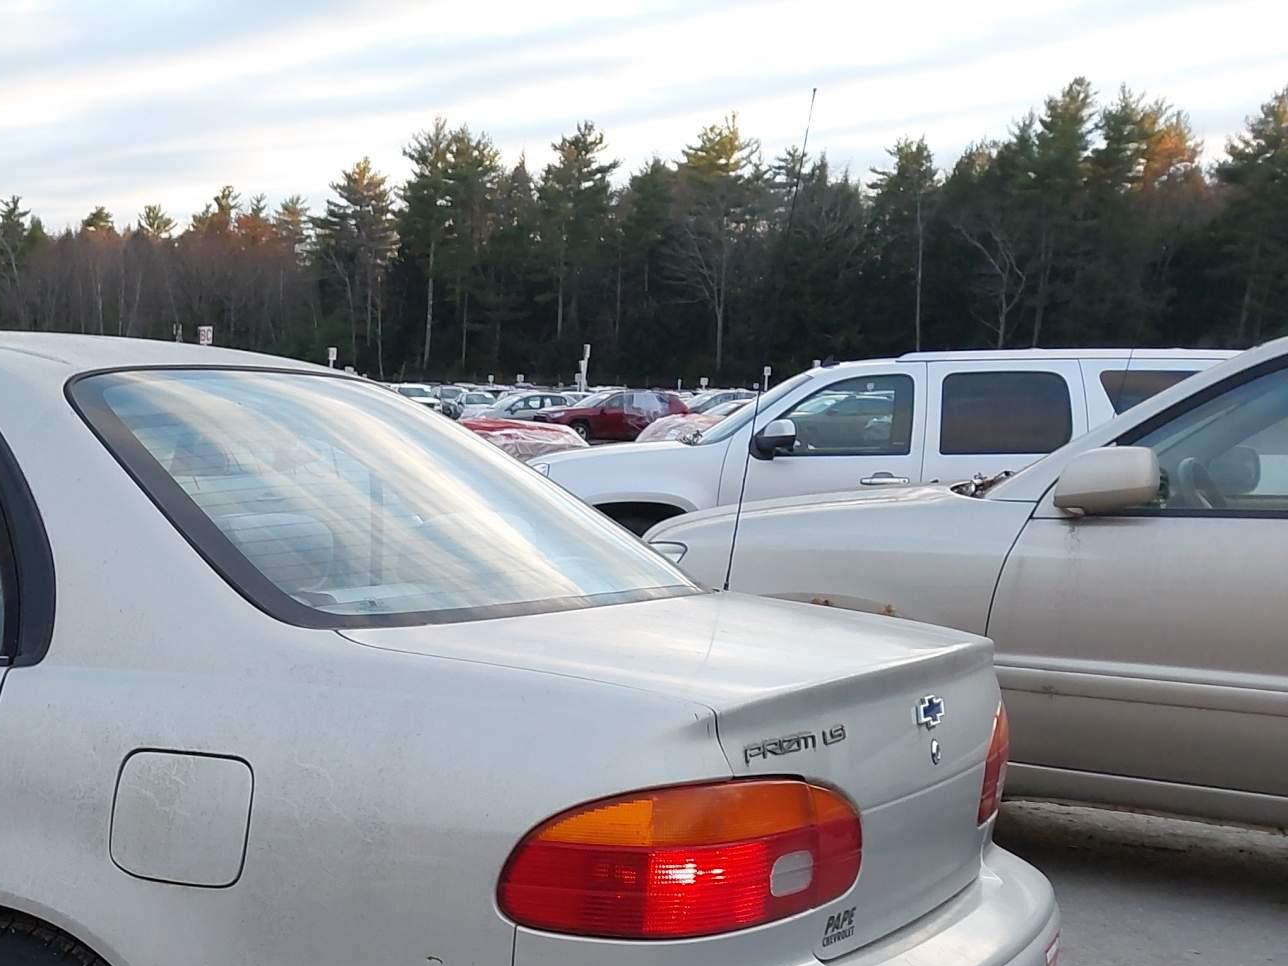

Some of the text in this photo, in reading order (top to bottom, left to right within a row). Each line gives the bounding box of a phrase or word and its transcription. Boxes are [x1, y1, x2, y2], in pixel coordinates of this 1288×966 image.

[822, 724, 846, 746] LS
[824, 906, 857, 935] PAPE
[822, 925, 856, 947] CHEVROLET
